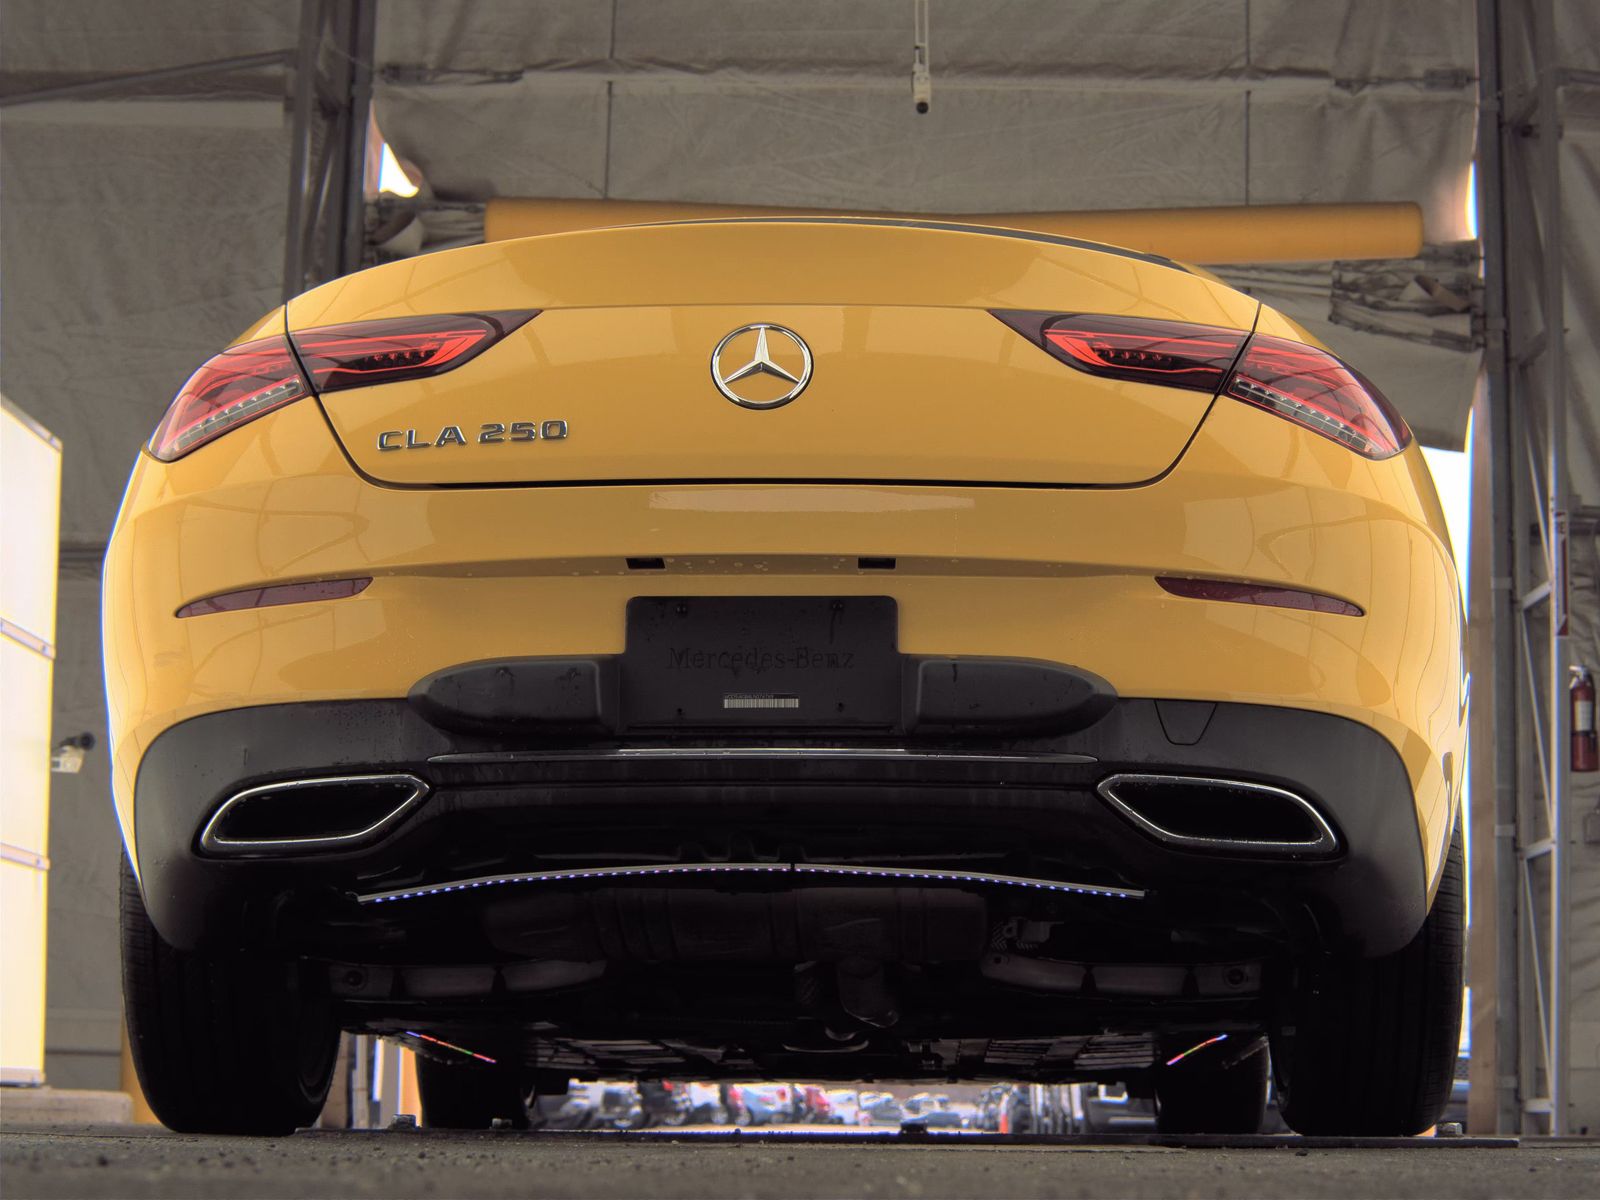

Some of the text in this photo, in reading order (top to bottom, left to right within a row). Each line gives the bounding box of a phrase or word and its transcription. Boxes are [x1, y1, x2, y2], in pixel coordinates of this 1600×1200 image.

[377, 419, 568, 451] CLA 250
[668, 647, 854, 670] Mercedes-Benz
